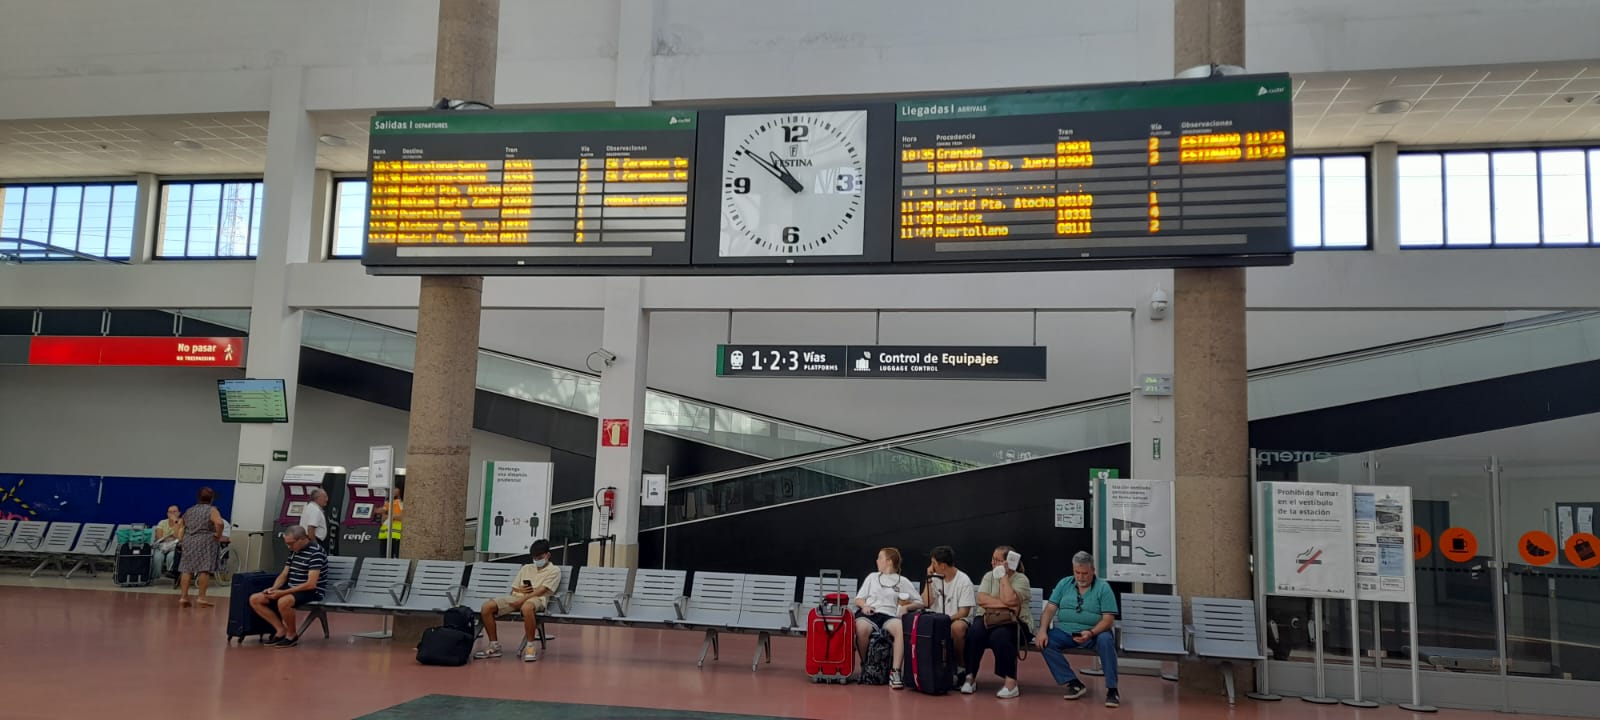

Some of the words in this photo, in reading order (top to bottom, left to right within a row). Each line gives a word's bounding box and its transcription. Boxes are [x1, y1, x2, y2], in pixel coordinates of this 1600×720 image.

[902, 104, 950, 117] Llegadas
[375, 120, 407, 130] Salidas
[936, 133, 976, 141] Procedencia
[1181, 120, 1232, 129] Observaciones
[782, 125, 809, 143] 12
[902, 148, 935, 161] 10:35
[936, 147, 984, 160] Granada
[1150, 137, 1160, 150] 2
[1180, 133, 1241, 148] ESTIMADO
[936, 160, 984, 172] Sevilla
[988, 158, 1014, 171] Sta.
[1021, 157, 1056, 170] Justa
[1150, 151, 1160, 164] 2
[1180, 147, 1242, 162] ESTIMADO
[734, 177, 751, 194] 9
[836, 174, 854, 192] 3
[901, 201, 934, 213] 11:29
[936, 199, 976, 212] Madrid
[981, 198, 1007, 210] Pta.
[1014, 197, 1056, 210] Atocha
[1150, 192, 1158, 204] 1
[576, 220, 584, 230] 4
[901, 214, 934, 226] 11:30
[936, 213, 984, 224] Badajoz
[782, 226, 800, 244] 6
[901, 228, 934, 240] 11:44
[936, 226, 1008, 238] Puertollano
[1150, 219, 1160, 232] 2
[576, 232, 584, 242] 2
[178, 343, 190, 352] No
[192, 344, 216, 354] pasar
[803, 352, 826, 363] Vías
[879, 352, 920, 364] Control
[924, 352, 939, 364] de
[942, 352, 999, 366] Equipajes
[1278, 488, 1314, 497] Prohibido
[344, 532, 372, 544] renfe
